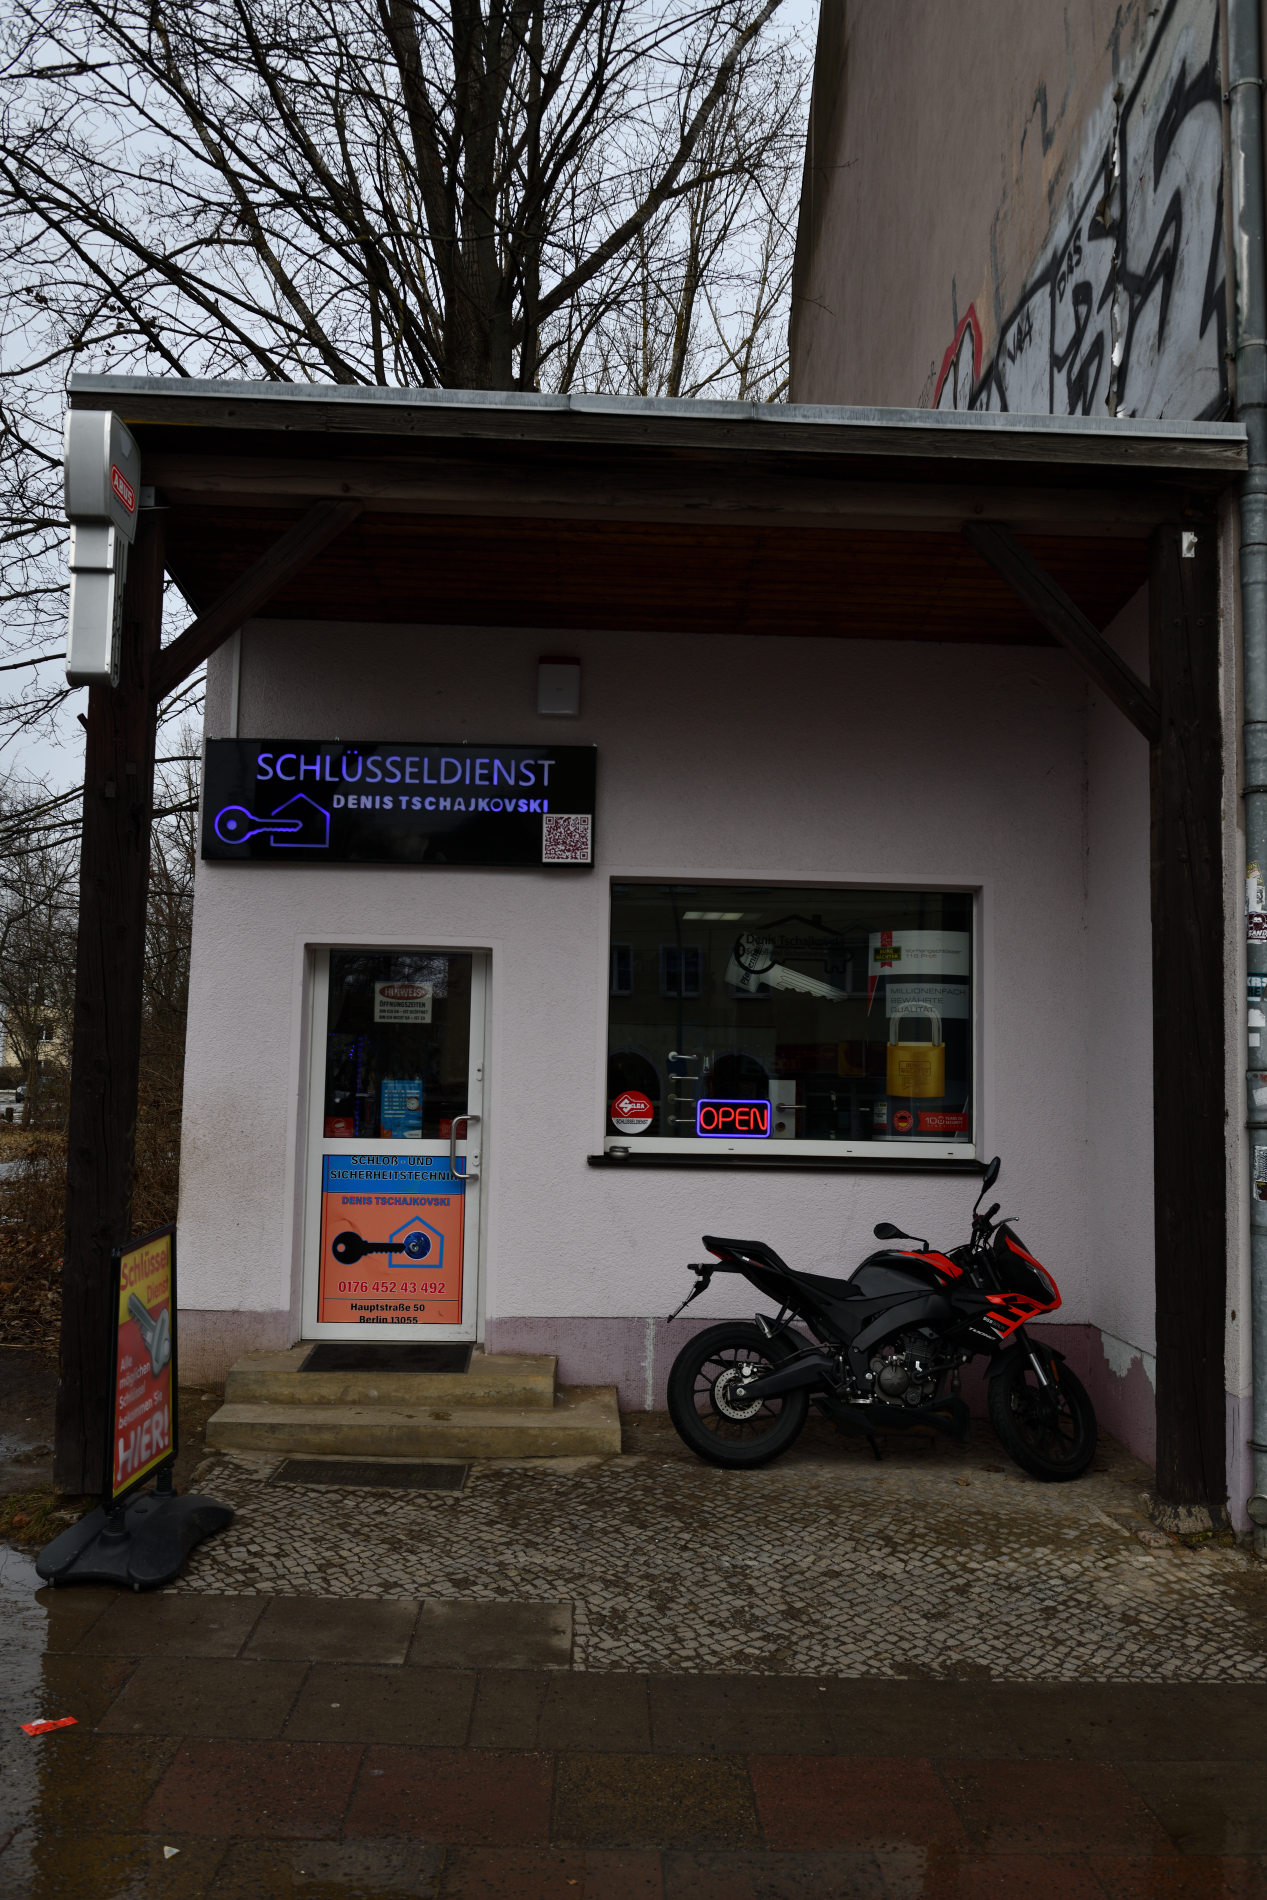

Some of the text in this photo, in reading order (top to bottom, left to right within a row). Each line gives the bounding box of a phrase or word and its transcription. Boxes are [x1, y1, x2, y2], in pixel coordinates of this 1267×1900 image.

[113, 472, 132, 507] ABUS
[256, 750, 556, 787] SCHLÜSSELDIENST
[333, 794, 549, 813] DENIS TSCHAJKOVSKI
[746, 934, 845, 948] Denis Tschajkovski
[384, 987, 421, 997] HINWEIS
[890, 987, 966, 996] MILLIONENFACH
[379, 1000, 426, 1008] ÖFFNUNGSZEITEN
[700, 1106, 768, 1131] OPEN
[408, 1157, 434, 1166] UND
[342, 1196, 451, 1207] DENIS TSCHAJKOVSKI
[120, 1240, 169, 1291] Schlüssel
[147, 1274, 169, 1304] Dienst
[338, 1281, 447, 1294] 0176 452 43 492
[350, 1303, 426, 1313] Hauptstraße 50
[359, 1316, 419, 1324] Berlin 13055
[120, 1355, 133, 1373] Alle
[119, 1362, 150, 1390] möglichen
[119, 1380, 146, 1410] Schlüssel
[118, 1390, 163, 1430] bekommen Sie
[117, 1403, 169, 1481] HIER!
